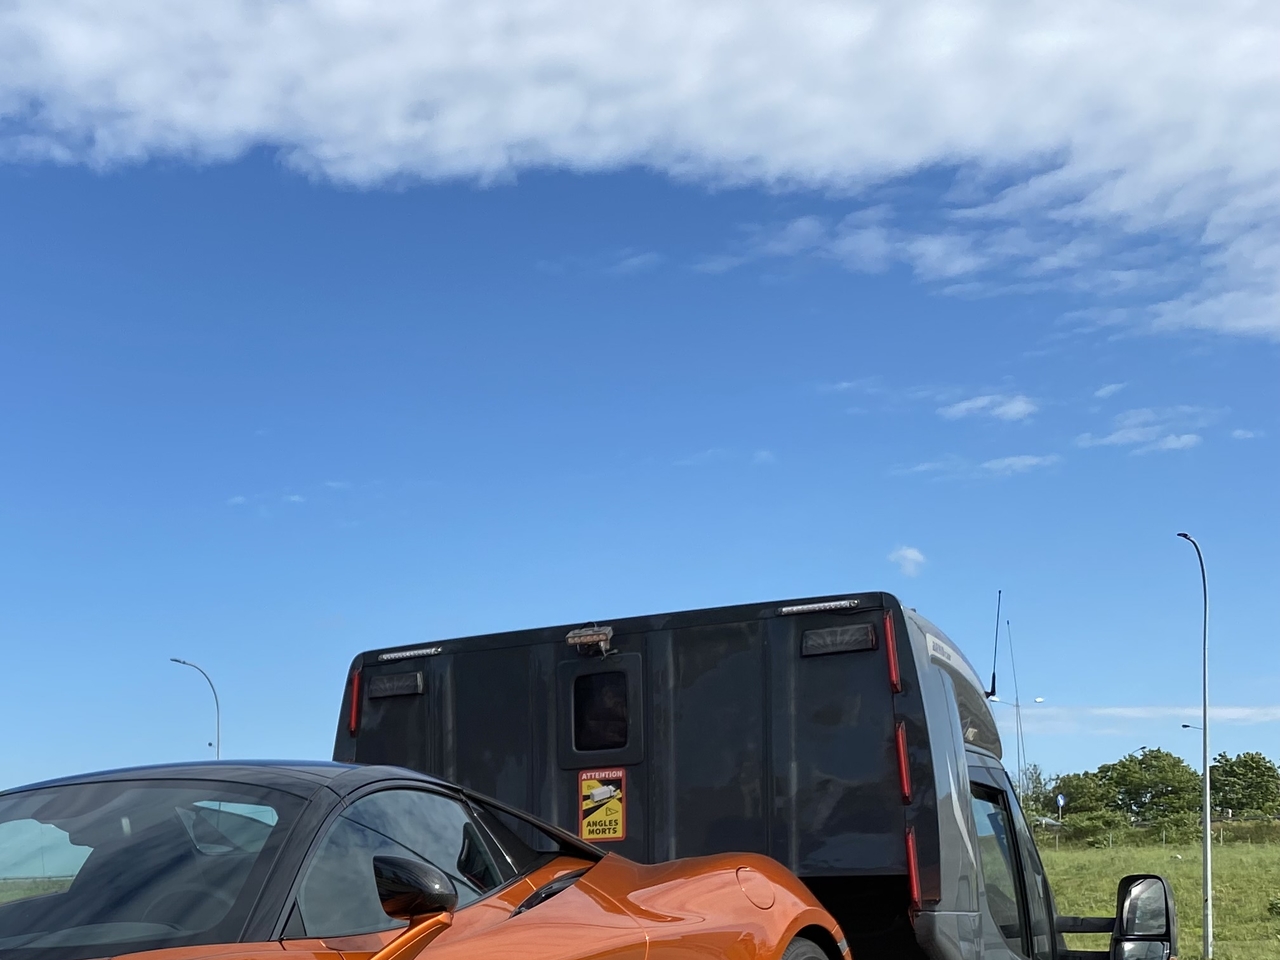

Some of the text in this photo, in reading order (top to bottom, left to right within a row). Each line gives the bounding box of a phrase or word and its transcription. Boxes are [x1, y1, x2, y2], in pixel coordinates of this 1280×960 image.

[581, 770, 623, 780] ATTENTION
[586, 819, 619, 828] ANGLES
[588, 827, 618, 836] MORTS
